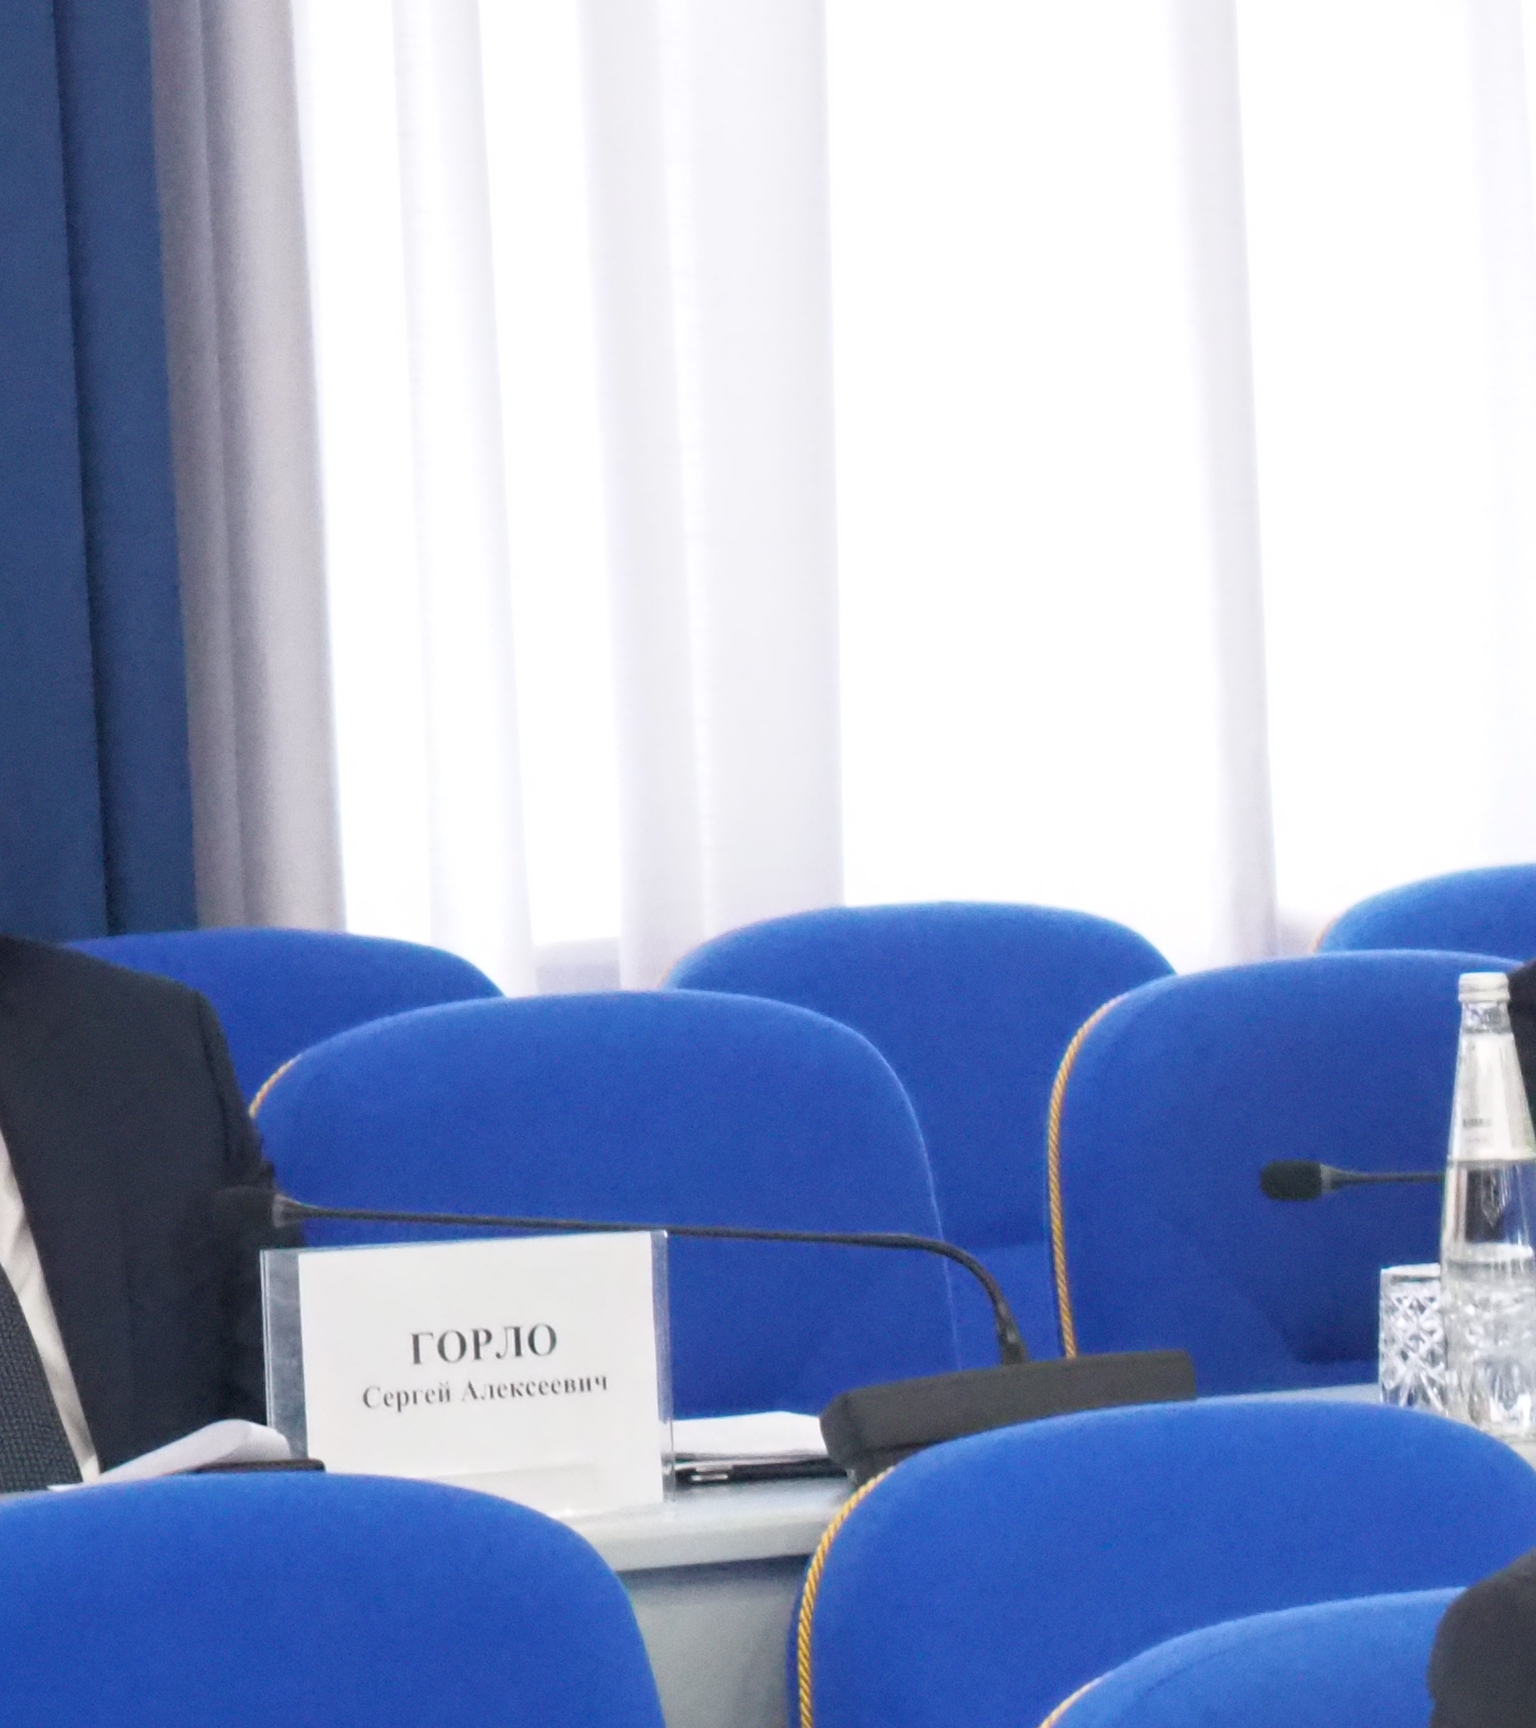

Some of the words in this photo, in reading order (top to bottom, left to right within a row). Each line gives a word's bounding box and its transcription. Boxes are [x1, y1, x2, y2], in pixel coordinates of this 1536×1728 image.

[410, 1323, 558, 1366] ГОРЛО
[362, 1380, 452, 1413] Сергей
[460, 1372, 609, 1403] Алексеевич
